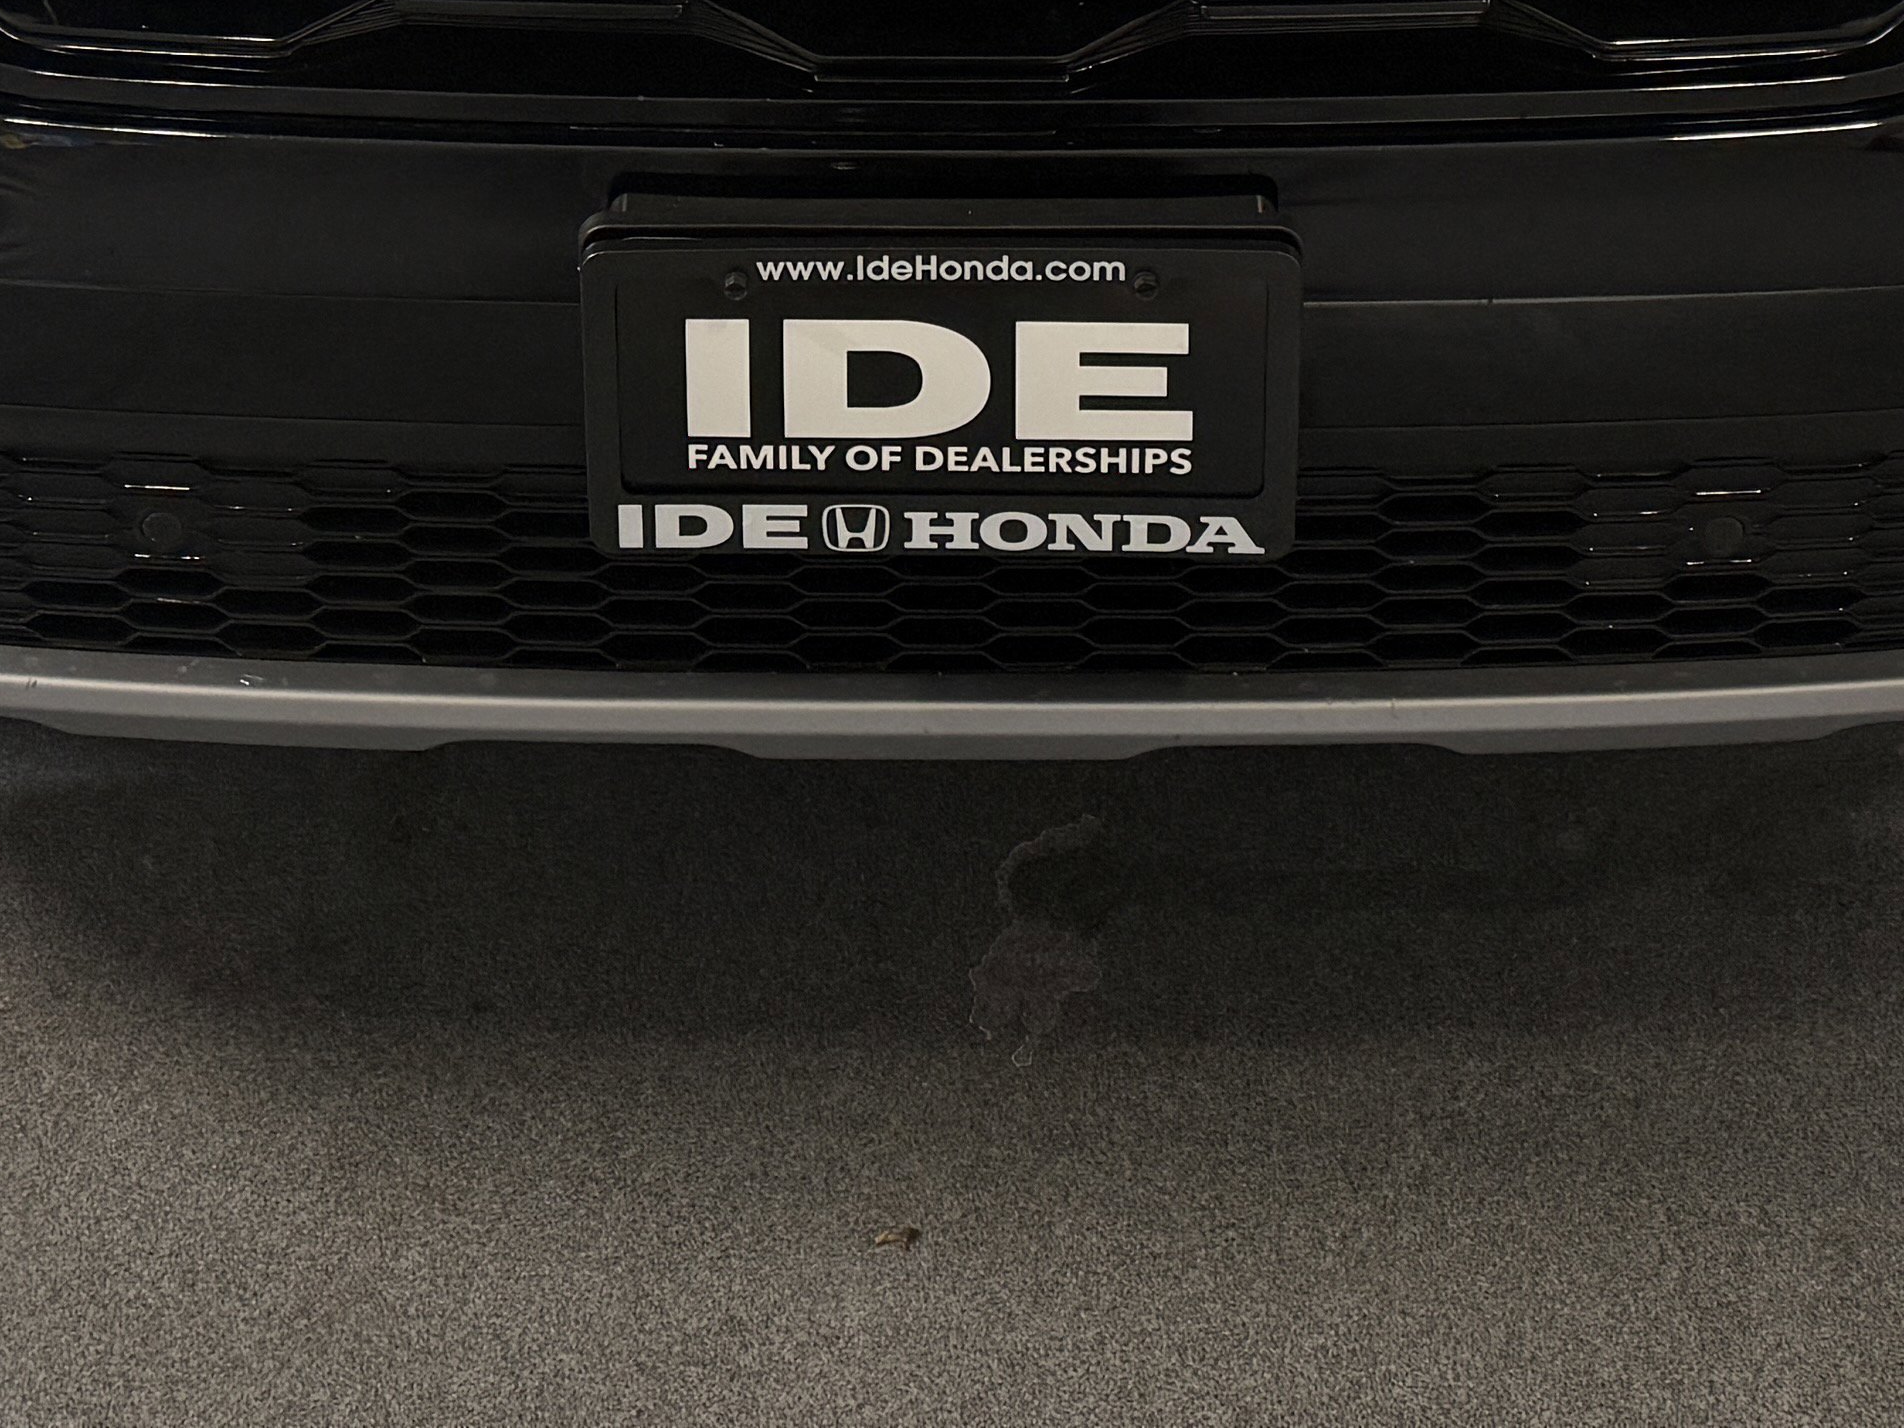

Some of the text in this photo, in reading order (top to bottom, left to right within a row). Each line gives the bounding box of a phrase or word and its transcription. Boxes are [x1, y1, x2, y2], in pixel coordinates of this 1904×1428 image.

[756, 255, 1126, 282] www.IdeHonda.com
[685, 318, 1194, 441] IDE
[688, 444, 1192, 475] FAMILY OF DEALERSHIPS
[617, 504, 809, 550] IDE
[904, 512, 1266, 555] HONDA
